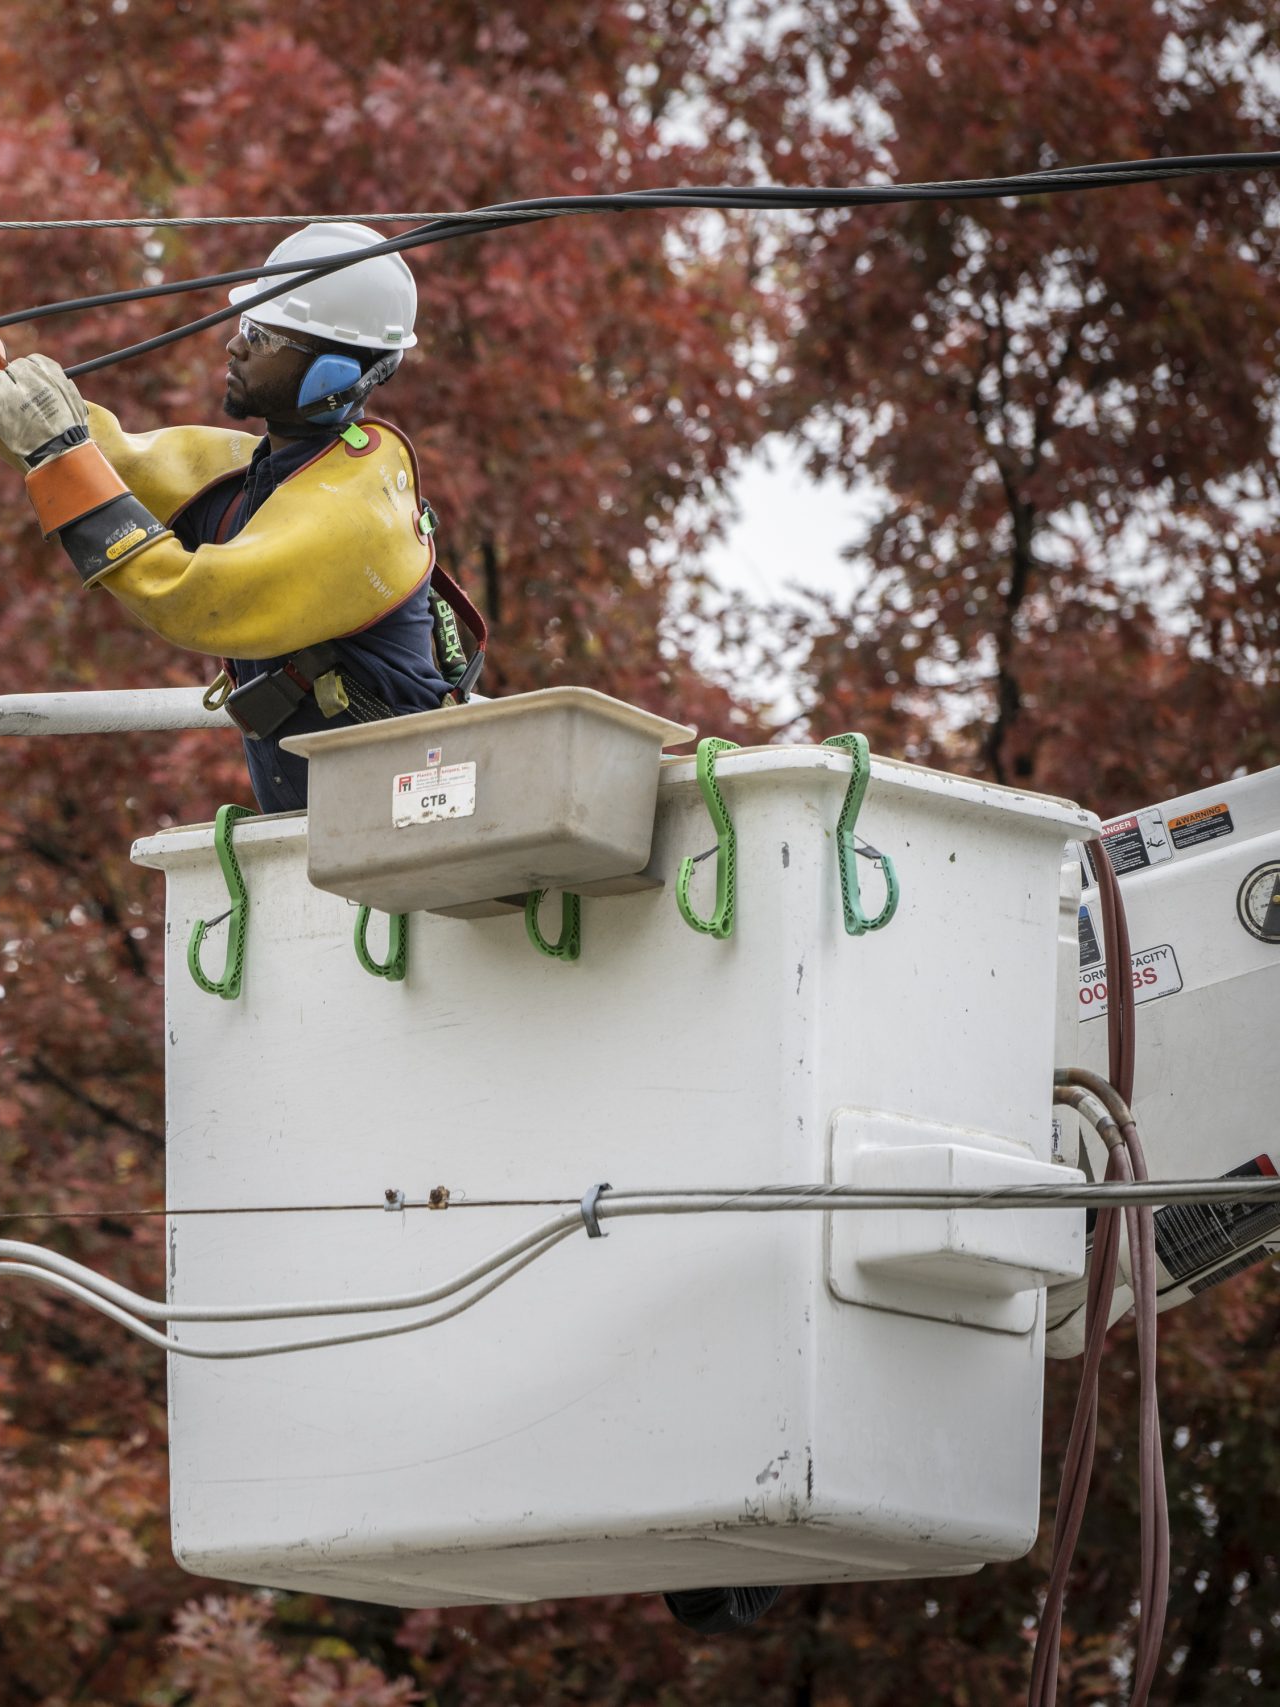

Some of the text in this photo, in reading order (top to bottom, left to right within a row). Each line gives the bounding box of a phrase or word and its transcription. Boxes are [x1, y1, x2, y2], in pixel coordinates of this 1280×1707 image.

[363, 565, 394, 600] HARRIS
[436, 600, 464, 663] BUCK
[420, 793, 447, 808] CTB
[1181, 806, 1221, 824] WARNING
[1101, 820, 1132, 835] ANGER
[1079, 948, 1168, 983] ORM ACITY
[1079, 967, 1158, 1004] 00 BS
